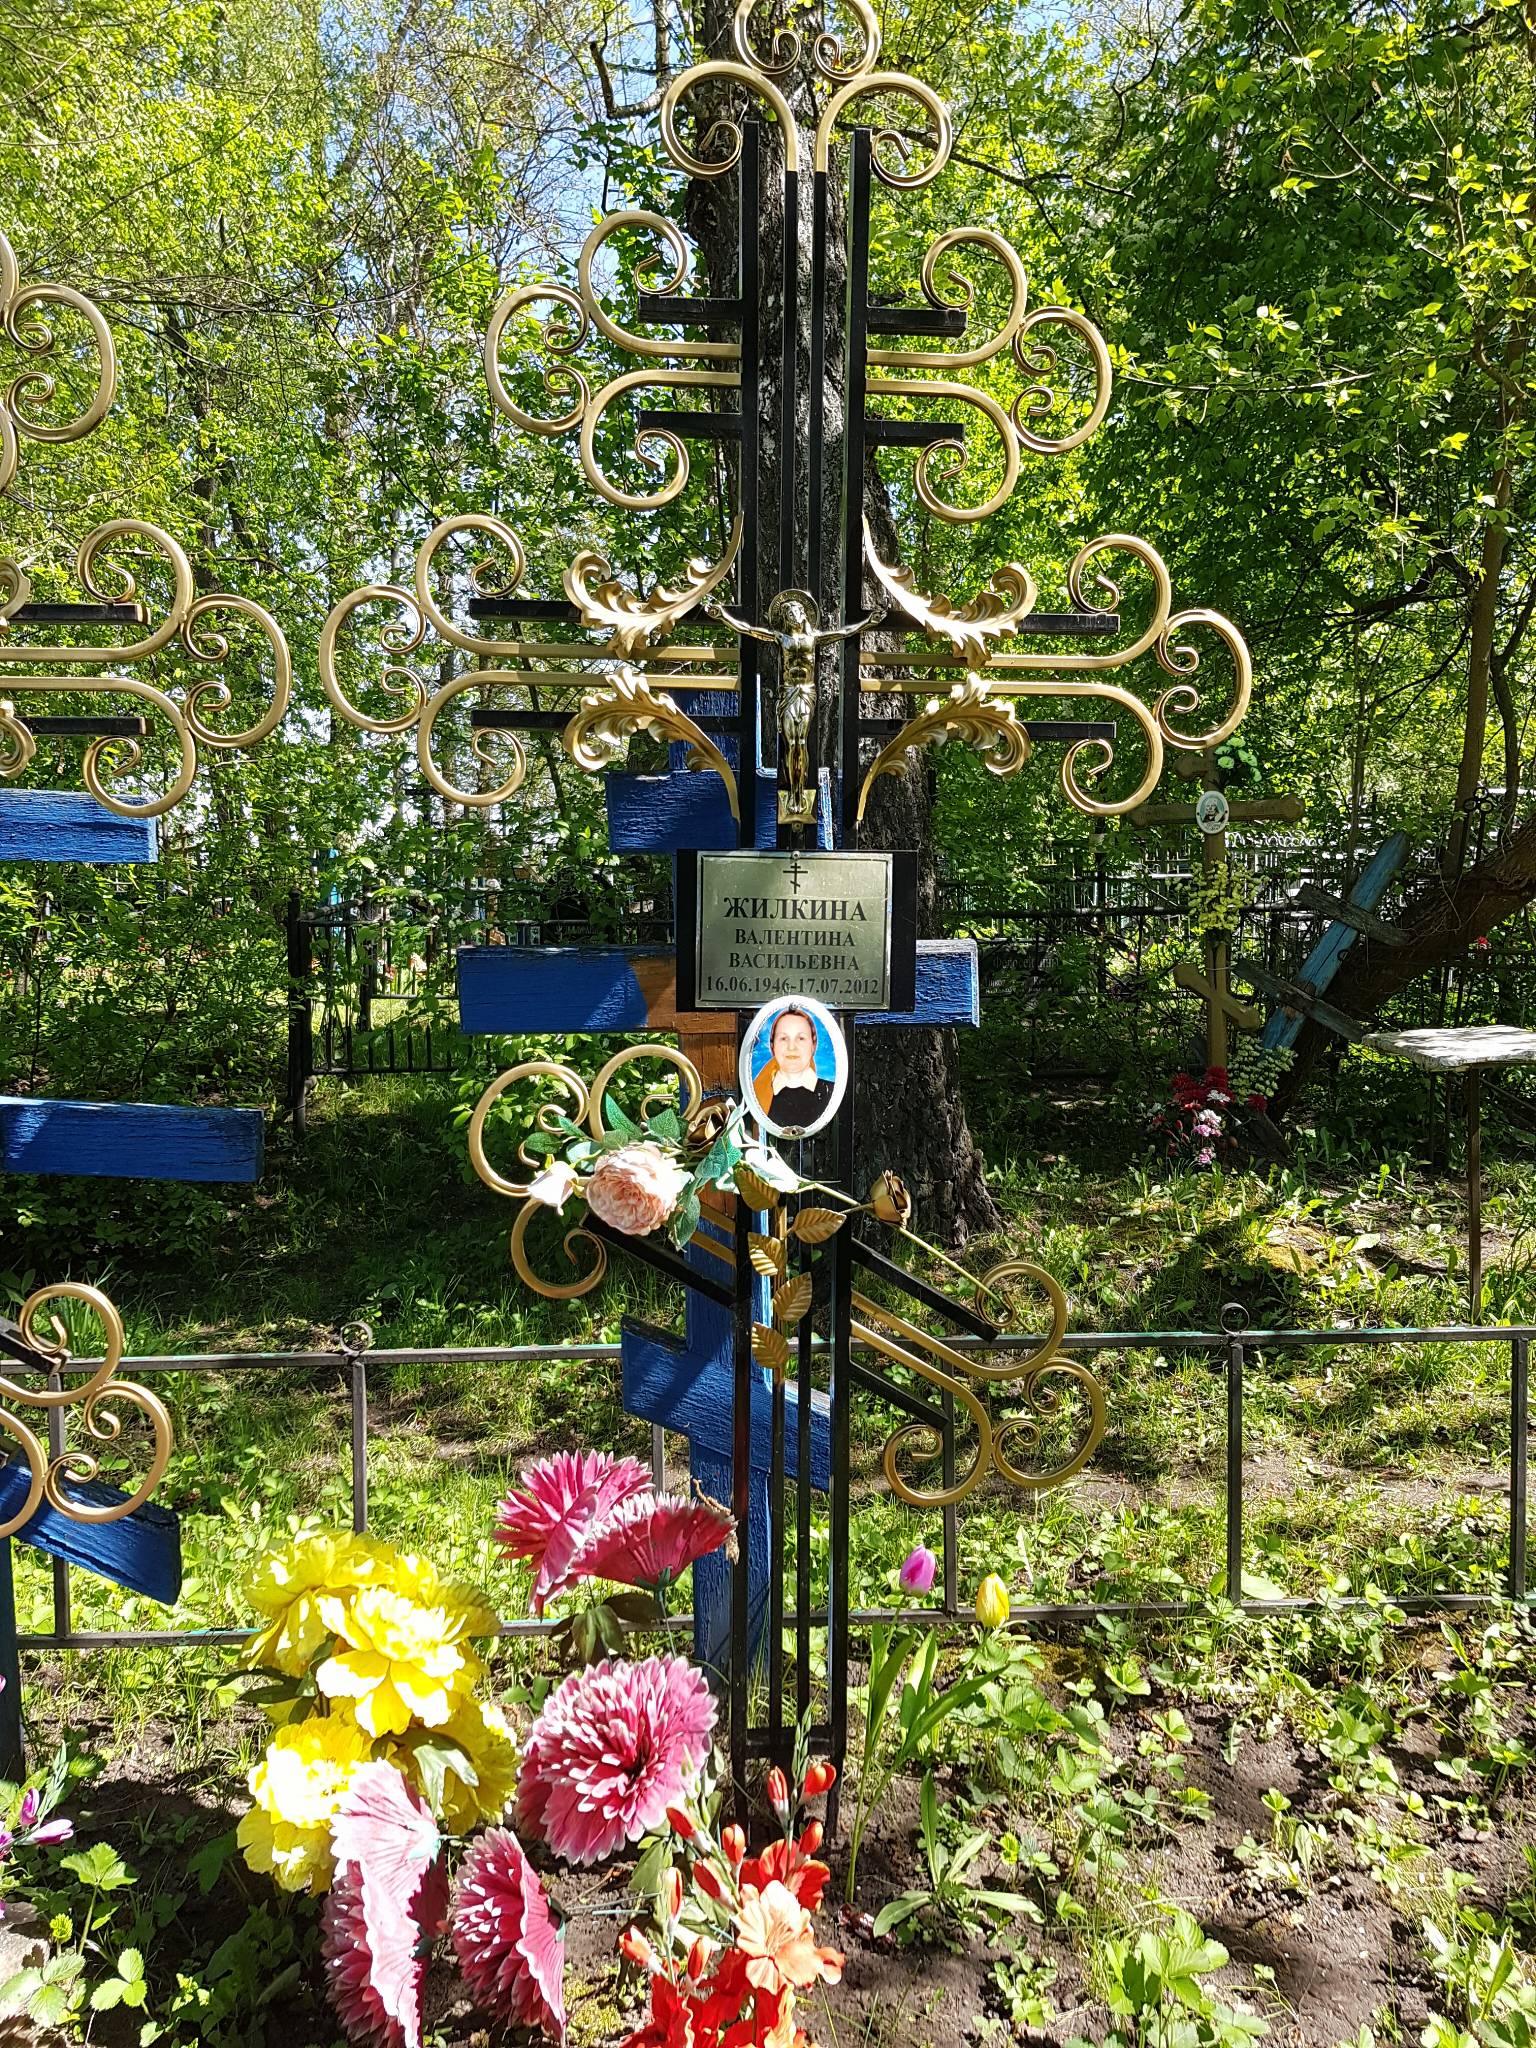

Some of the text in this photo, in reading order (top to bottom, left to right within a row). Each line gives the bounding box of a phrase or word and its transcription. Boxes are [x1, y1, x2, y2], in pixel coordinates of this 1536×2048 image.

[723, 897, 867, 921] ЖИЛКИНА
[735, 928, 855, 947] ВАЛЕНТИНА
[728, 952, 860, 971] ВАСИЛЬЕВНА
